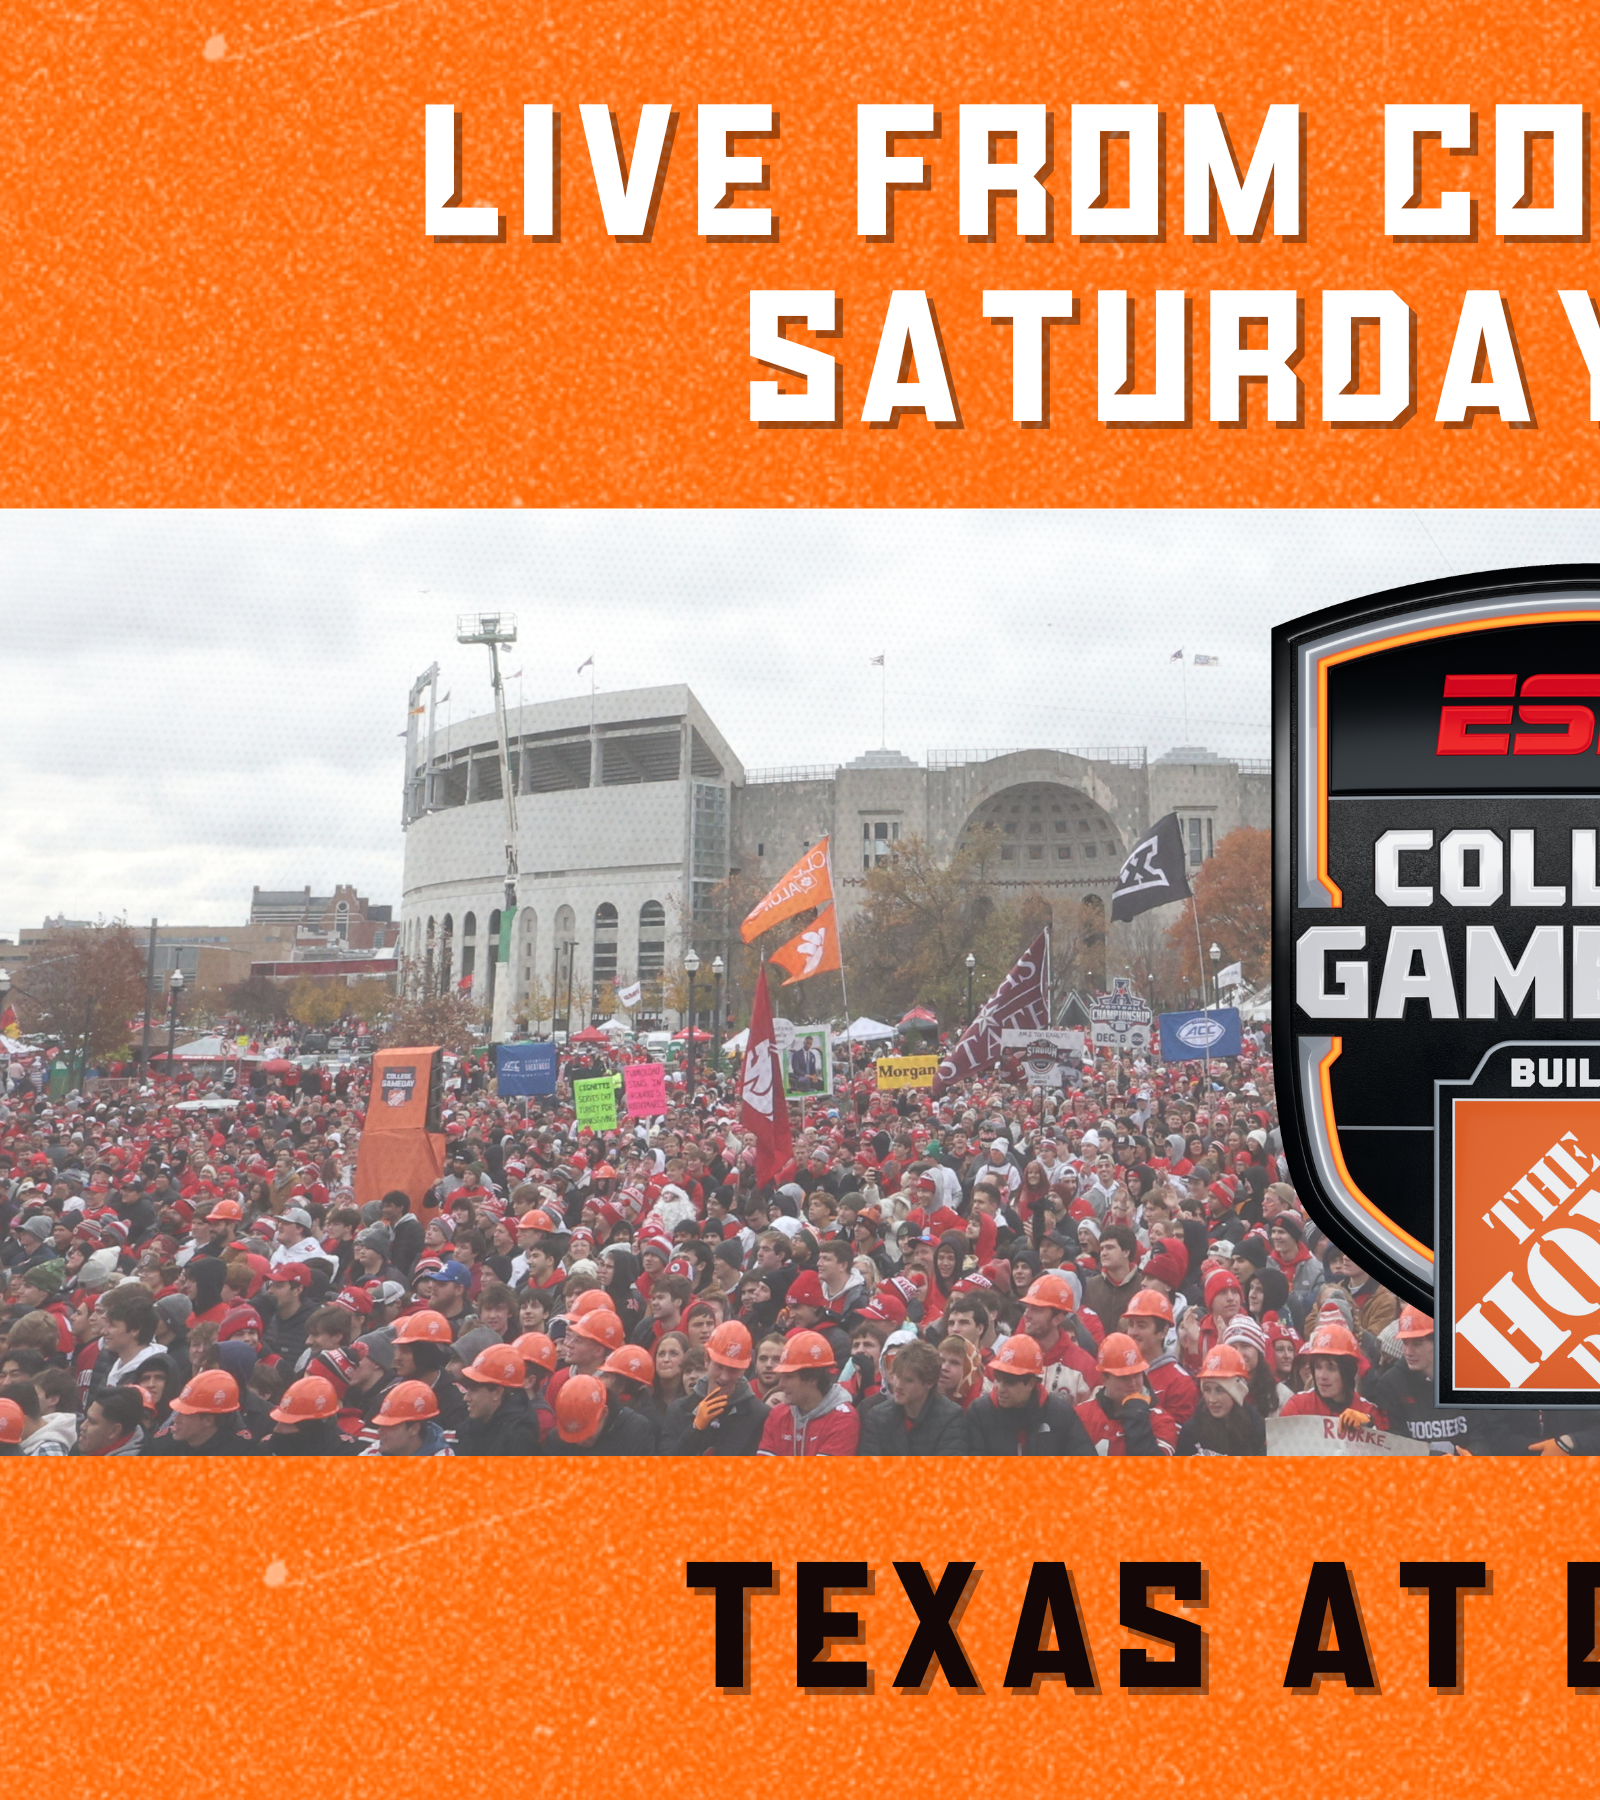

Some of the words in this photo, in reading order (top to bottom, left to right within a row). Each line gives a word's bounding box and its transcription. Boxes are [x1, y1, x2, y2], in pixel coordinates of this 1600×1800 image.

[1092, 1009, 1150, 1024] CHAMPIONSHIP
[1184, 1025, 1217, 1036] ACC
[1096, 1033, 1118, 1043] DEC.
[1119, 1034, 1126, 1044] 6
[1026, 1046, 1057, 1058] STADIUM
[879, 1065, 936, 1080] Morgan
[1406, 1416, 1468, 1439] HOOSIES
